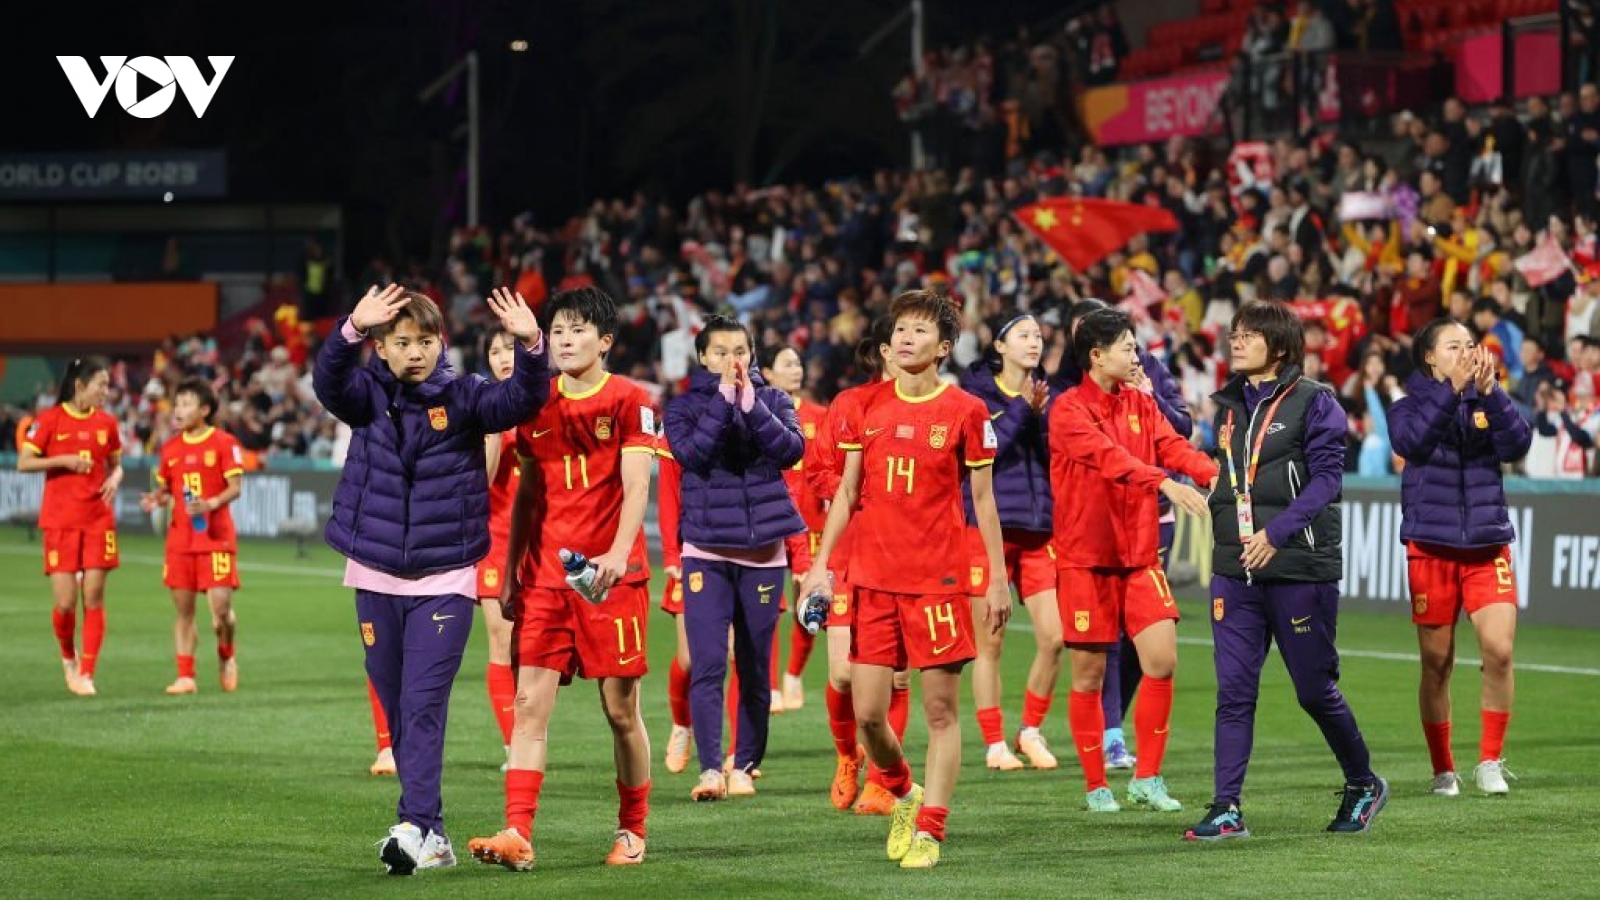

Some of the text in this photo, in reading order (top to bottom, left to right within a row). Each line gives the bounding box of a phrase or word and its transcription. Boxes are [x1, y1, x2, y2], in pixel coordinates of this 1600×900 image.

[70, 162, 120, 187] CUP
[183, 472, 202, 496] 19
[563, 453, 589, 489] 11
[886, 455, 915, 494] 14
[105, 530, 117, 554] 9
[212, 551, 231, 574] 19
[1494, 557, 1512, 585] 2
[614, 616, 641, 653] 11
[924, 602, 957, 642] 14
